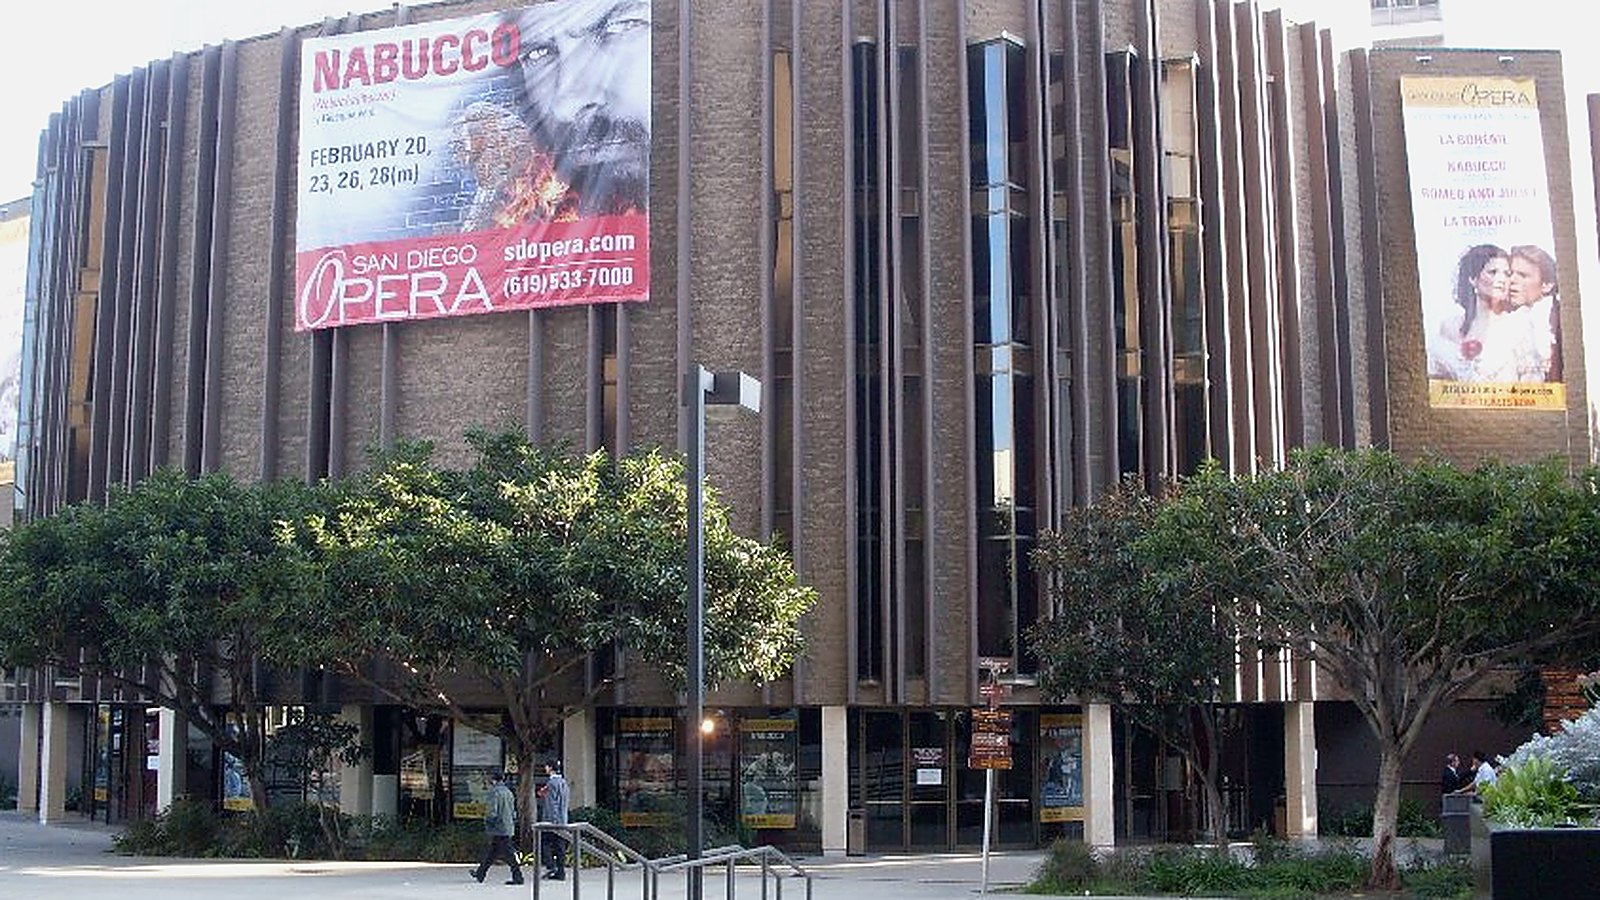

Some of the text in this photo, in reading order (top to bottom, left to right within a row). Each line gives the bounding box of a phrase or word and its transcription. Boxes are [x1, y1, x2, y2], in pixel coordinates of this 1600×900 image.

[312, 22, 522, 94] NABUCCO
[1461, 82, 1531, 105] OPERA
[310, 136, 432, 168] FEBRUARY 20,
[309, 174, 334, 195] 23,
[338, 170, 364, 190] 26,
[352, 245, 478, 275] SAN DIEGO
[504, 234, 635, 262] sdopera.com
[301, 250, 495, 329] OPERA
